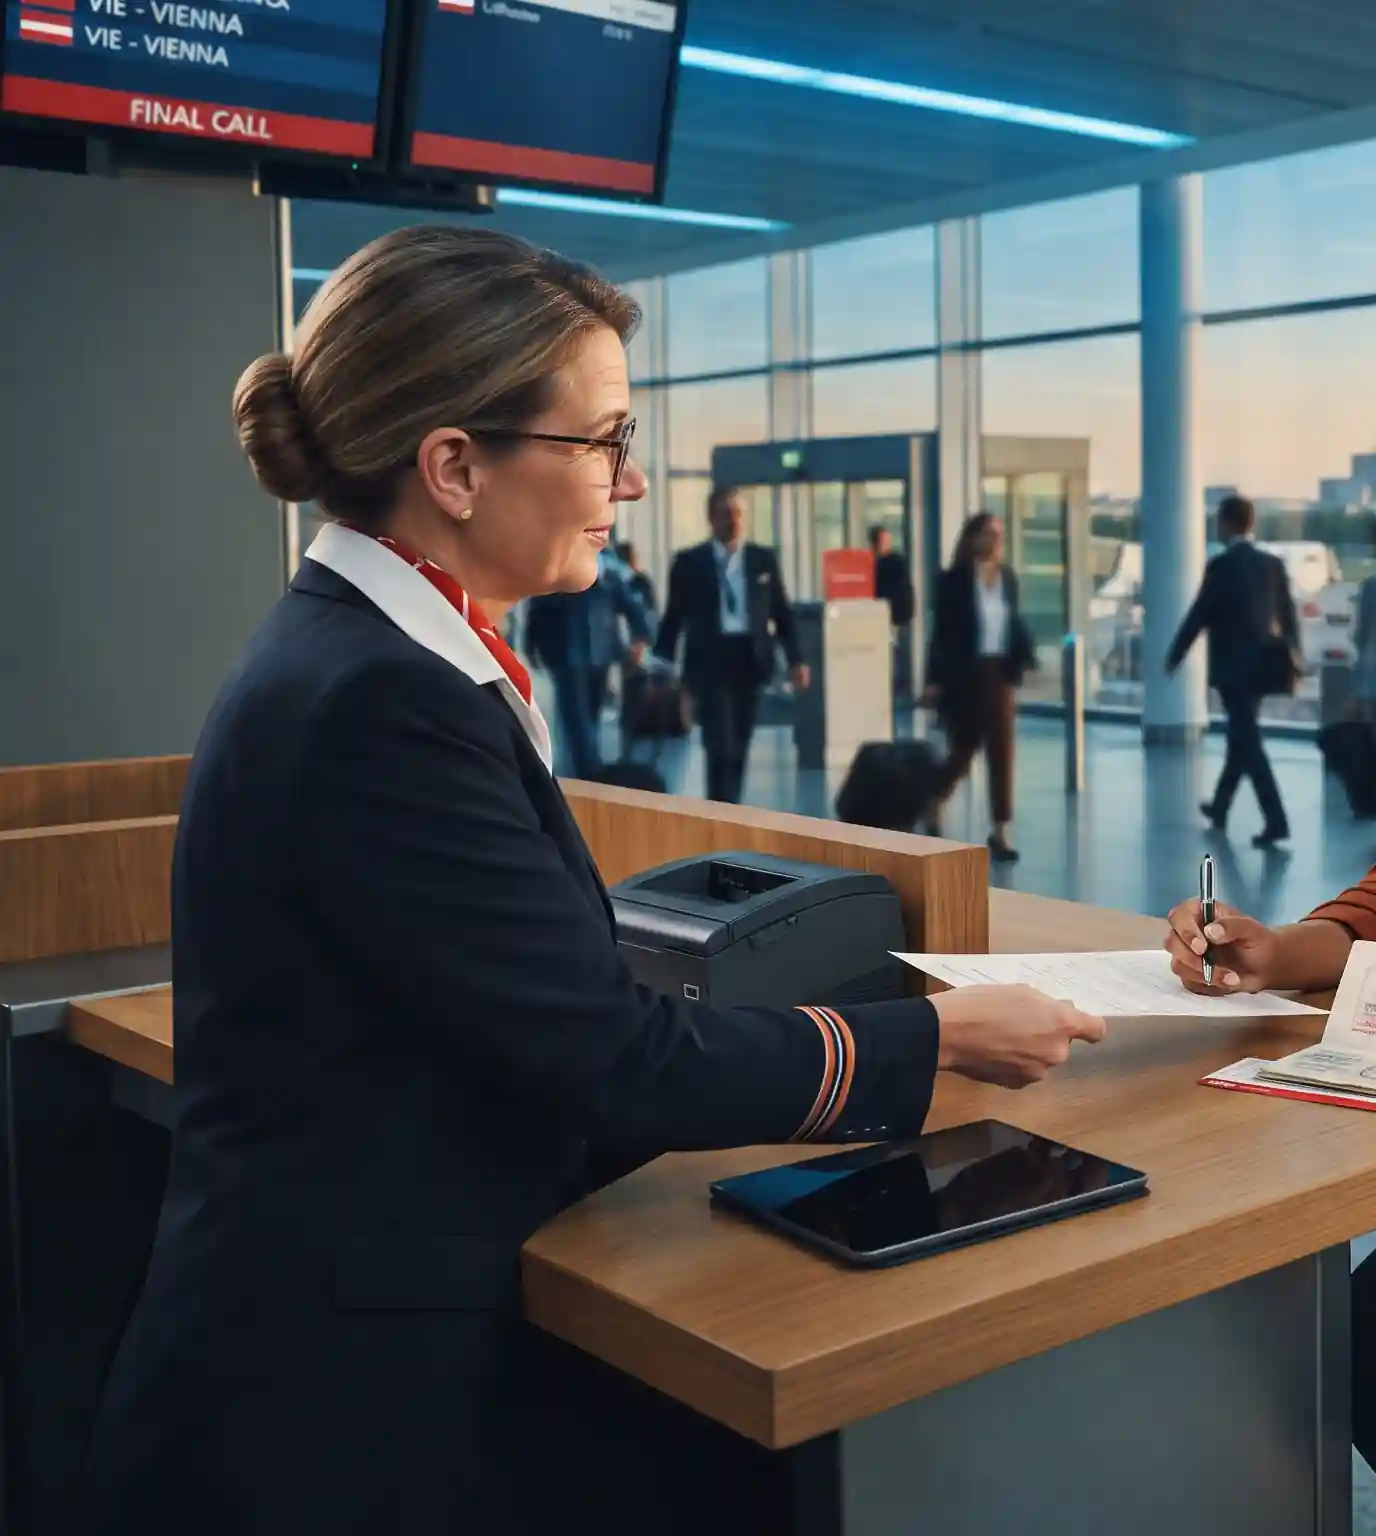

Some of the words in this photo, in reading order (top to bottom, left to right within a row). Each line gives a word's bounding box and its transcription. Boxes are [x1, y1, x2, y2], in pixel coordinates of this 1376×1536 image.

[89, 0, 127, 17] VIE
[150, 0, 243, 36] VIENNA
[84, 24, 122, 50] VIE
[143, 33, 229, 67] VIENNA
[130, 97, 205, 130] FINAL
[211, 109, 273, 139] CALL
